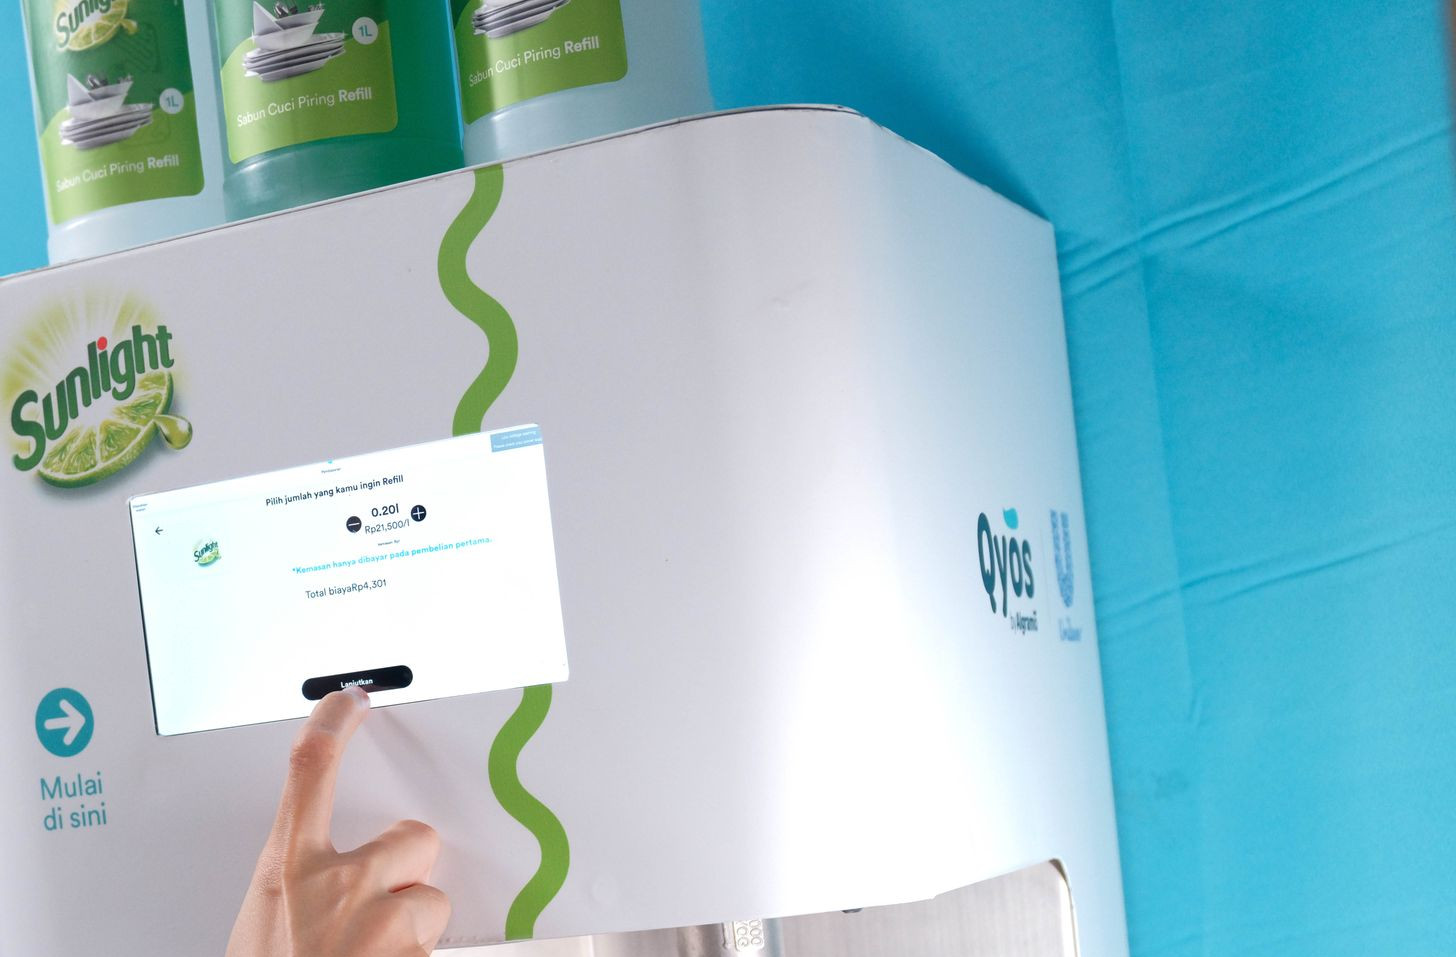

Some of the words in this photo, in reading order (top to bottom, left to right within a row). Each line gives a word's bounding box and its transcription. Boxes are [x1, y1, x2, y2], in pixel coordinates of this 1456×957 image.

[358, 25, 373, 37] 1L
[469, 66, 494, 87] Sabun
[495, 54, 521, 73] Cuci
[523, 47, 561, 64] Piring
[564, 35, 600, 54] Refill
[165, 96, 179, 108] 1L
[237, 109, 266, 127] Sabun
[267, 98, 295, 116] Cuci
[298, 93, 335, 108] Piring
[338, 87, 372, 102] Refill
[56, 176, 81, 192] Sabun
[82, 166, 107, 183] Cuci
[109, 159, 144, 174] Piring
[147, 154, 180, 169] Refill
[11, 324, 174, 471] Sunlight
[266, 496, 283, 506] Pilih
[284, 491, 312, 505] jumlah
[313, 488, 334, 499] yang
[335, 484, 358, 494] kamu
[359, 479, 381, 490] ingin
[382, 474, 404, 486] Refill
[364, 518, 410, 534] Rp21,500/l
[193, 541, 219, 562] Sunlight
[332, 559, 356, 570] hanya
[358, 552, 388, 565] dibayar
[389, 549, 410, 561] pada
[411, 542, 454, 557] pembelian
[455, 536, 493, 549] pertama.
[977, 511, 1035, 618] Qyos
[305, 588, 327, 599] Total
[40, 771, 103, 800] Mulai
[43, 806, 63, 831] di
[69, 801, 107, 828] sini
